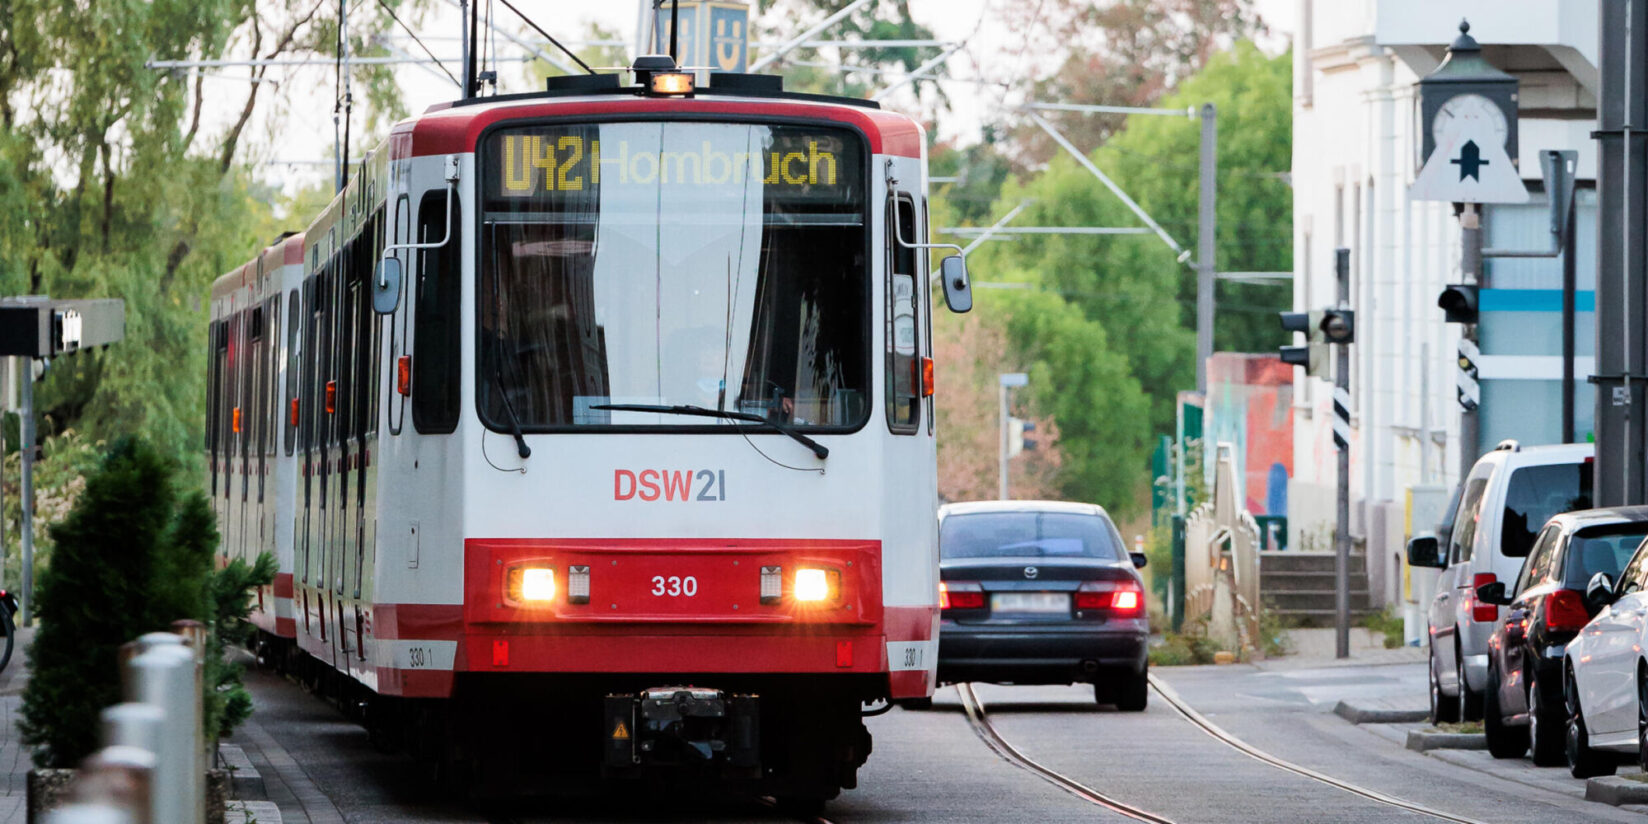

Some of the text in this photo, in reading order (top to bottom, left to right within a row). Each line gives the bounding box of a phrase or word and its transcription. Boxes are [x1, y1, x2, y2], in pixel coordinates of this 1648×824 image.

[717, 19, 741, 71] U
[506, 135, 837, 190] U42 Hombruch
[614, 468, 726, 502] DSW21
[651, 575, 698, 597] 330
[409, 647, 425, 667] 330
